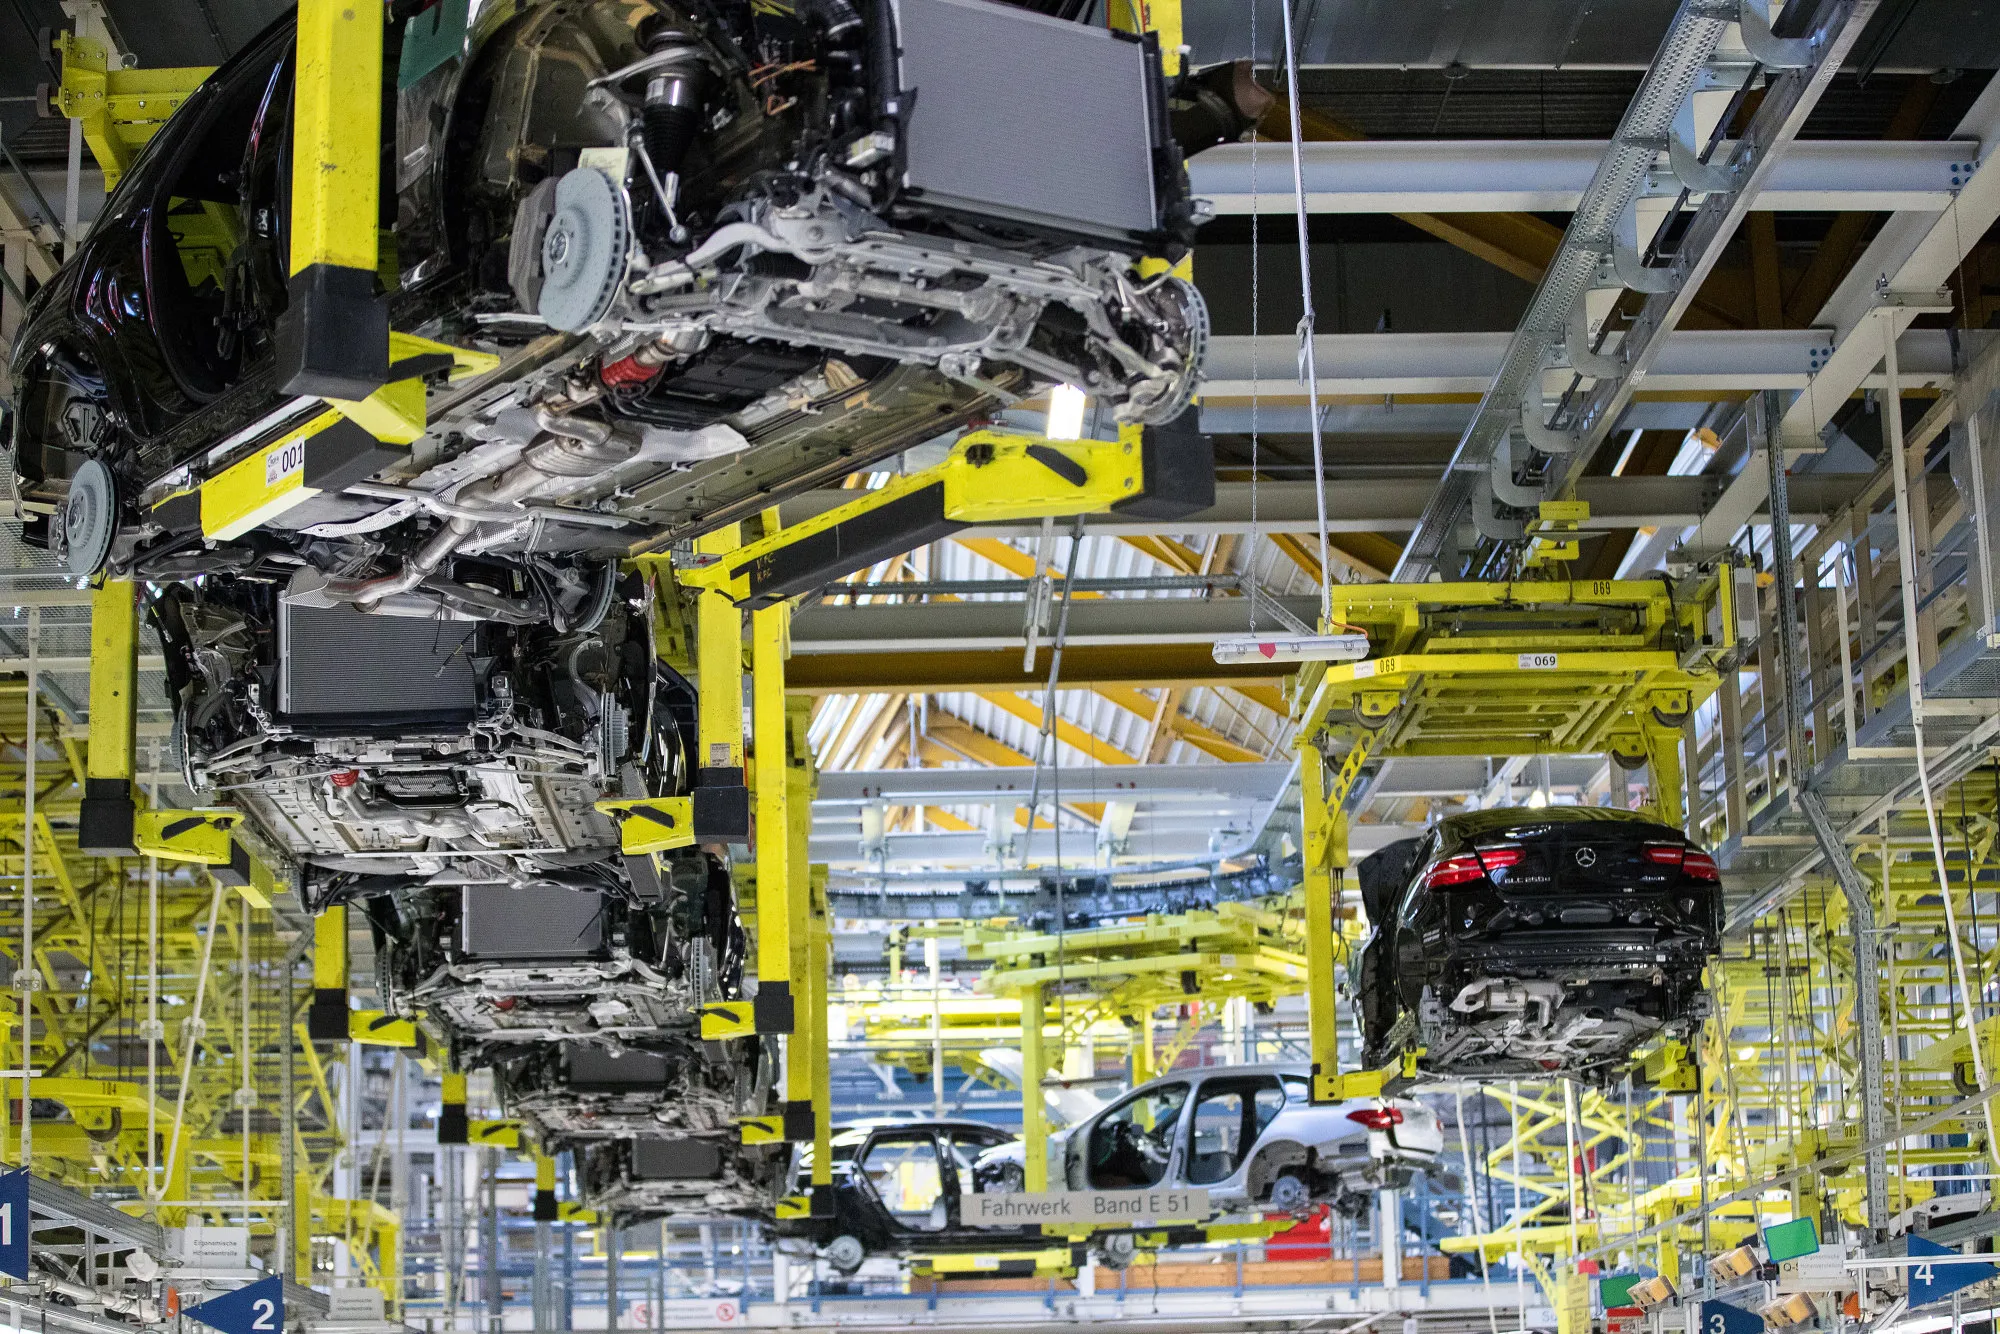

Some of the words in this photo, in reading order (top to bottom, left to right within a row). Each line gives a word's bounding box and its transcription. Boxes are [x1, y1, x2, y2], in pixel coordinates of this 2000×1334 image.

[282, 442, 303, 473] 001
[1593, 581, 1611, 595] 069
[1379, 657, 1395, 673] 069
[1534, 655, 1556, 667] 069
[981, 1198, 1072, 1217] Fahrwerk
[1094, 1196, 1142, 1214] Band
[1150, 1195, 1160, 1213] E
[1167, 1195, 1190, 1212] 51
[0, 1202, 12, 1246] 1
[1914, 1263, 1935, 1286] 4
[252, 1298, 275, 1330] 2
[1710, 1313, 1726, 1334] 3
